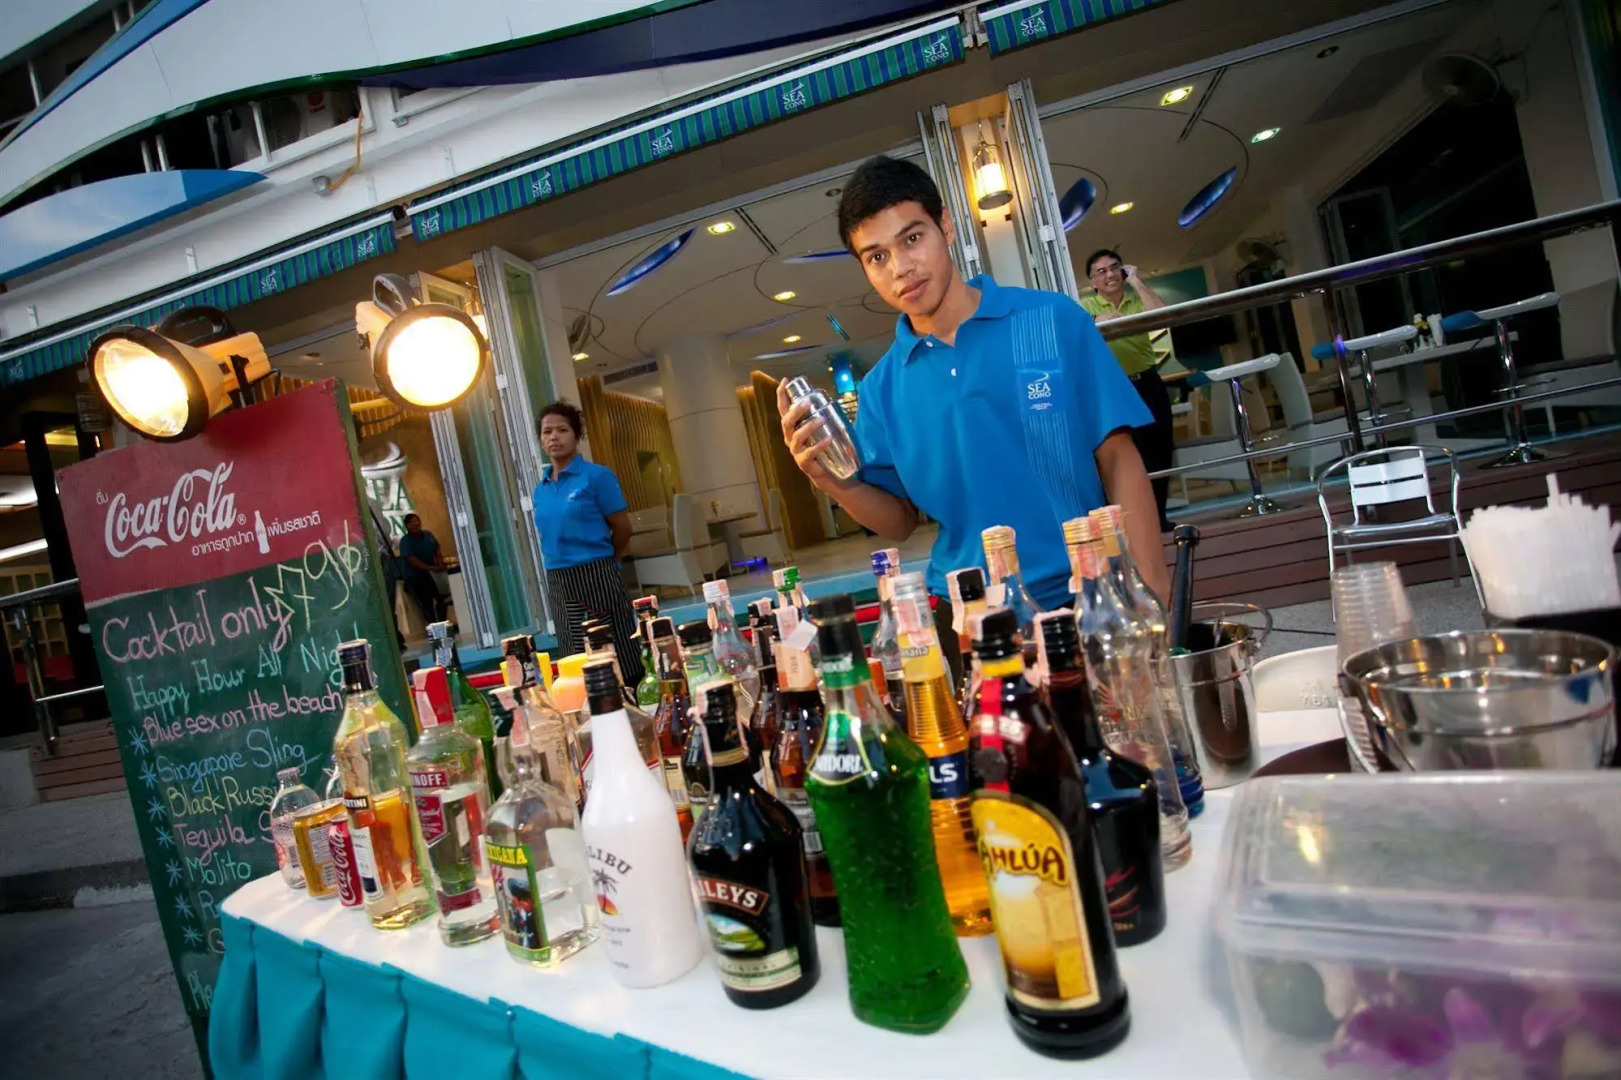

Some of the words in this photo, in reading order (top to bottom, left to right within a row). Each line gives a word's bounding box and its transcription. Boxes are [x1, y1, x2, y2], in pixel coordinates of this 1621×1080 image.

[1020, 18, 1046, 30] SEA
[924, 43, 948, 58] SEA
[782, 91, 805, 104] SEA
[651, 136, 673, 150] SEA
[531, 178, 551, 191] SEA
[421, 219, 439, 230] SEA
[1027, 382, 1051, 393] SEA
[104, 461, 236, 558] Coca-Cola
[192, 531, 255, 557] อาหารถูกปาก
[267, 510, 322, 537] เพิ่มรสชาติ
[102, 589, 216, 663] Cocktail
[126, 674, 190, 721] Happy
[191, 658, 246, 694] Hour
[257, 642, 282, 678] All
[143, 715, 184, 747] Blue
[186, 713, 218, 735] sex
[222, 708, 247, 730] on
[247, 686, 285, 722] the
[282, 683, 344, 714] beach
[156, 747, 247, 793] Singapore
[247, 727, 318, 776] Sling
[929, 763, 959, 784] LS
[411, 773, 444, 787] NOFF
[167, 777, 225, 818] Black
[221, 776, 276, 813] Russ
[173, 814, 255, 866] Tequila
[185, 850, 251, 887] Mojito
[586, 845, 633, 876] LIBU
[979, 839, 1066, 883] AHLÚA
[698, 878, 758, 909] ILEYS
